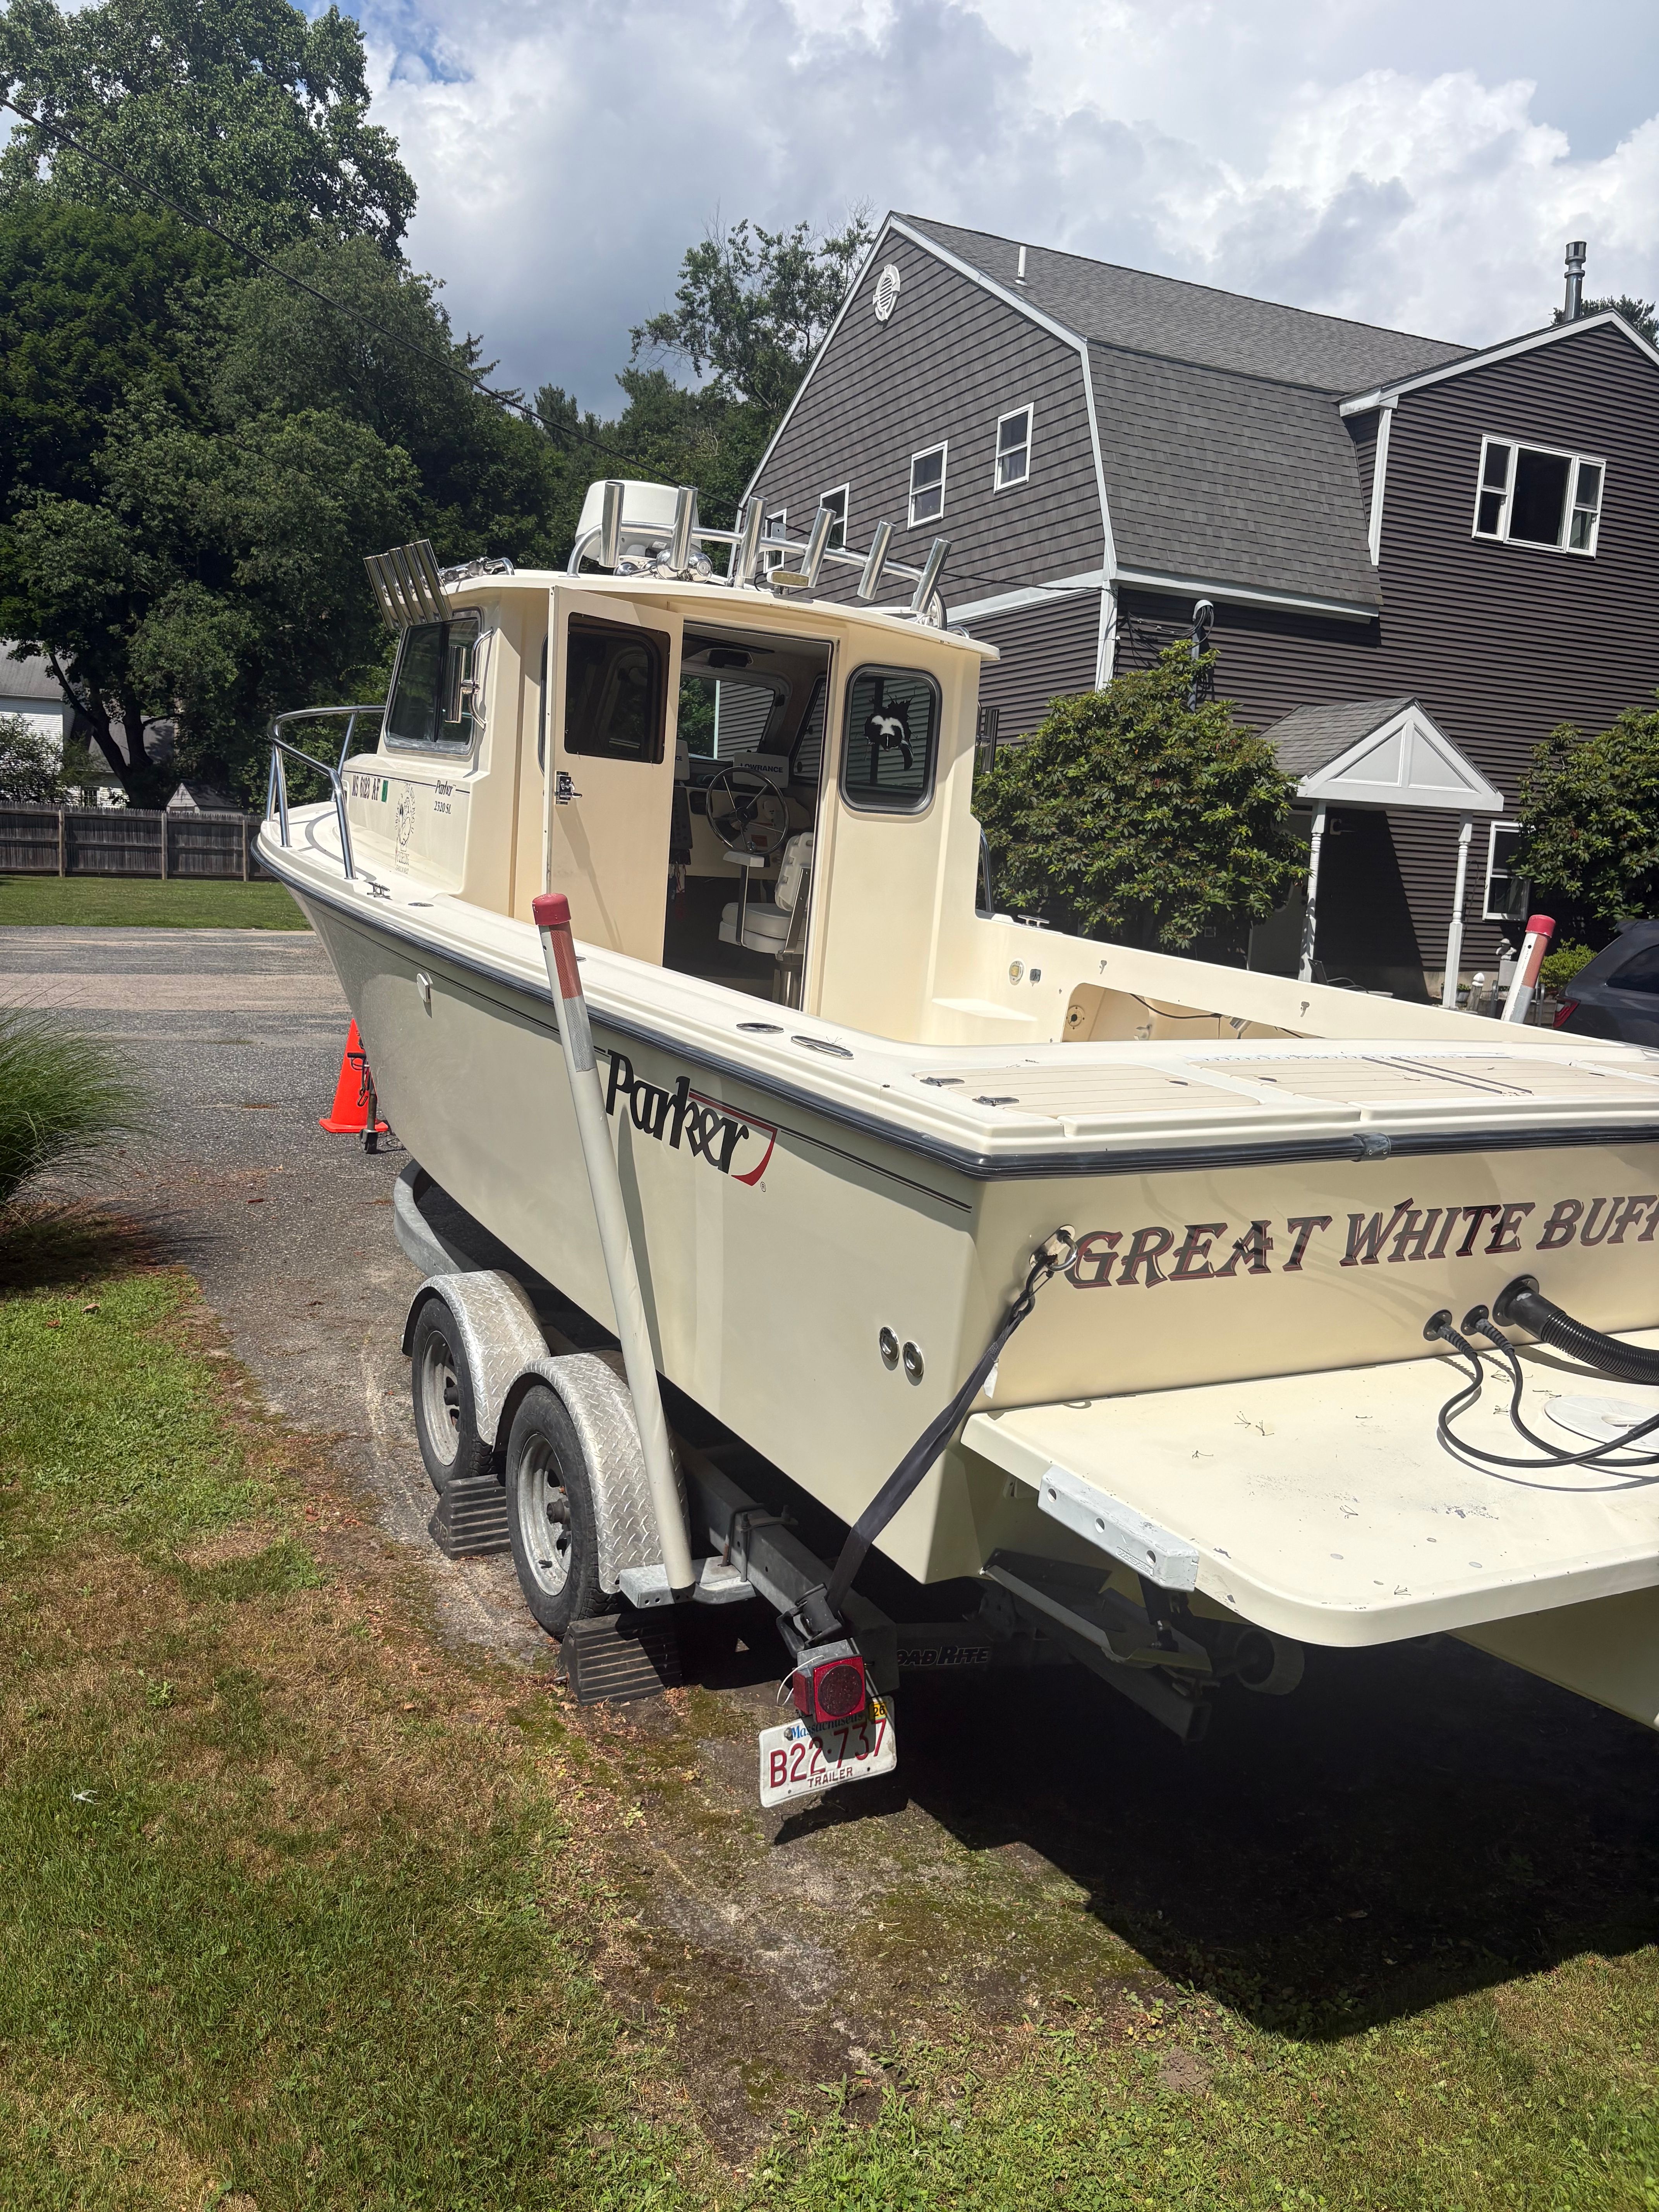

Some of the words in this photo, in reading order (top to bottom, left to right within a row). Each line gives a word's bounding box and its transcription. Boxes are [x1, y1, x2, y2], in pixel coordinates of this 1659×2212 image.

[740, 763, 783, 773] LOWRANCE
[435, 780, 453, 796] Parker
[434, 800, 445, 812] 2320
[445, 803, 451, 814] SL
[606, 1049, 749, 1174] Parker
[1063, 1215, 1333, 1289] GREAT
[1339, 1197, 1536, 1267] WHITE
[874, 1705, 886, 1717] 26
[807, 1767, 853, 1788] TRAILER
